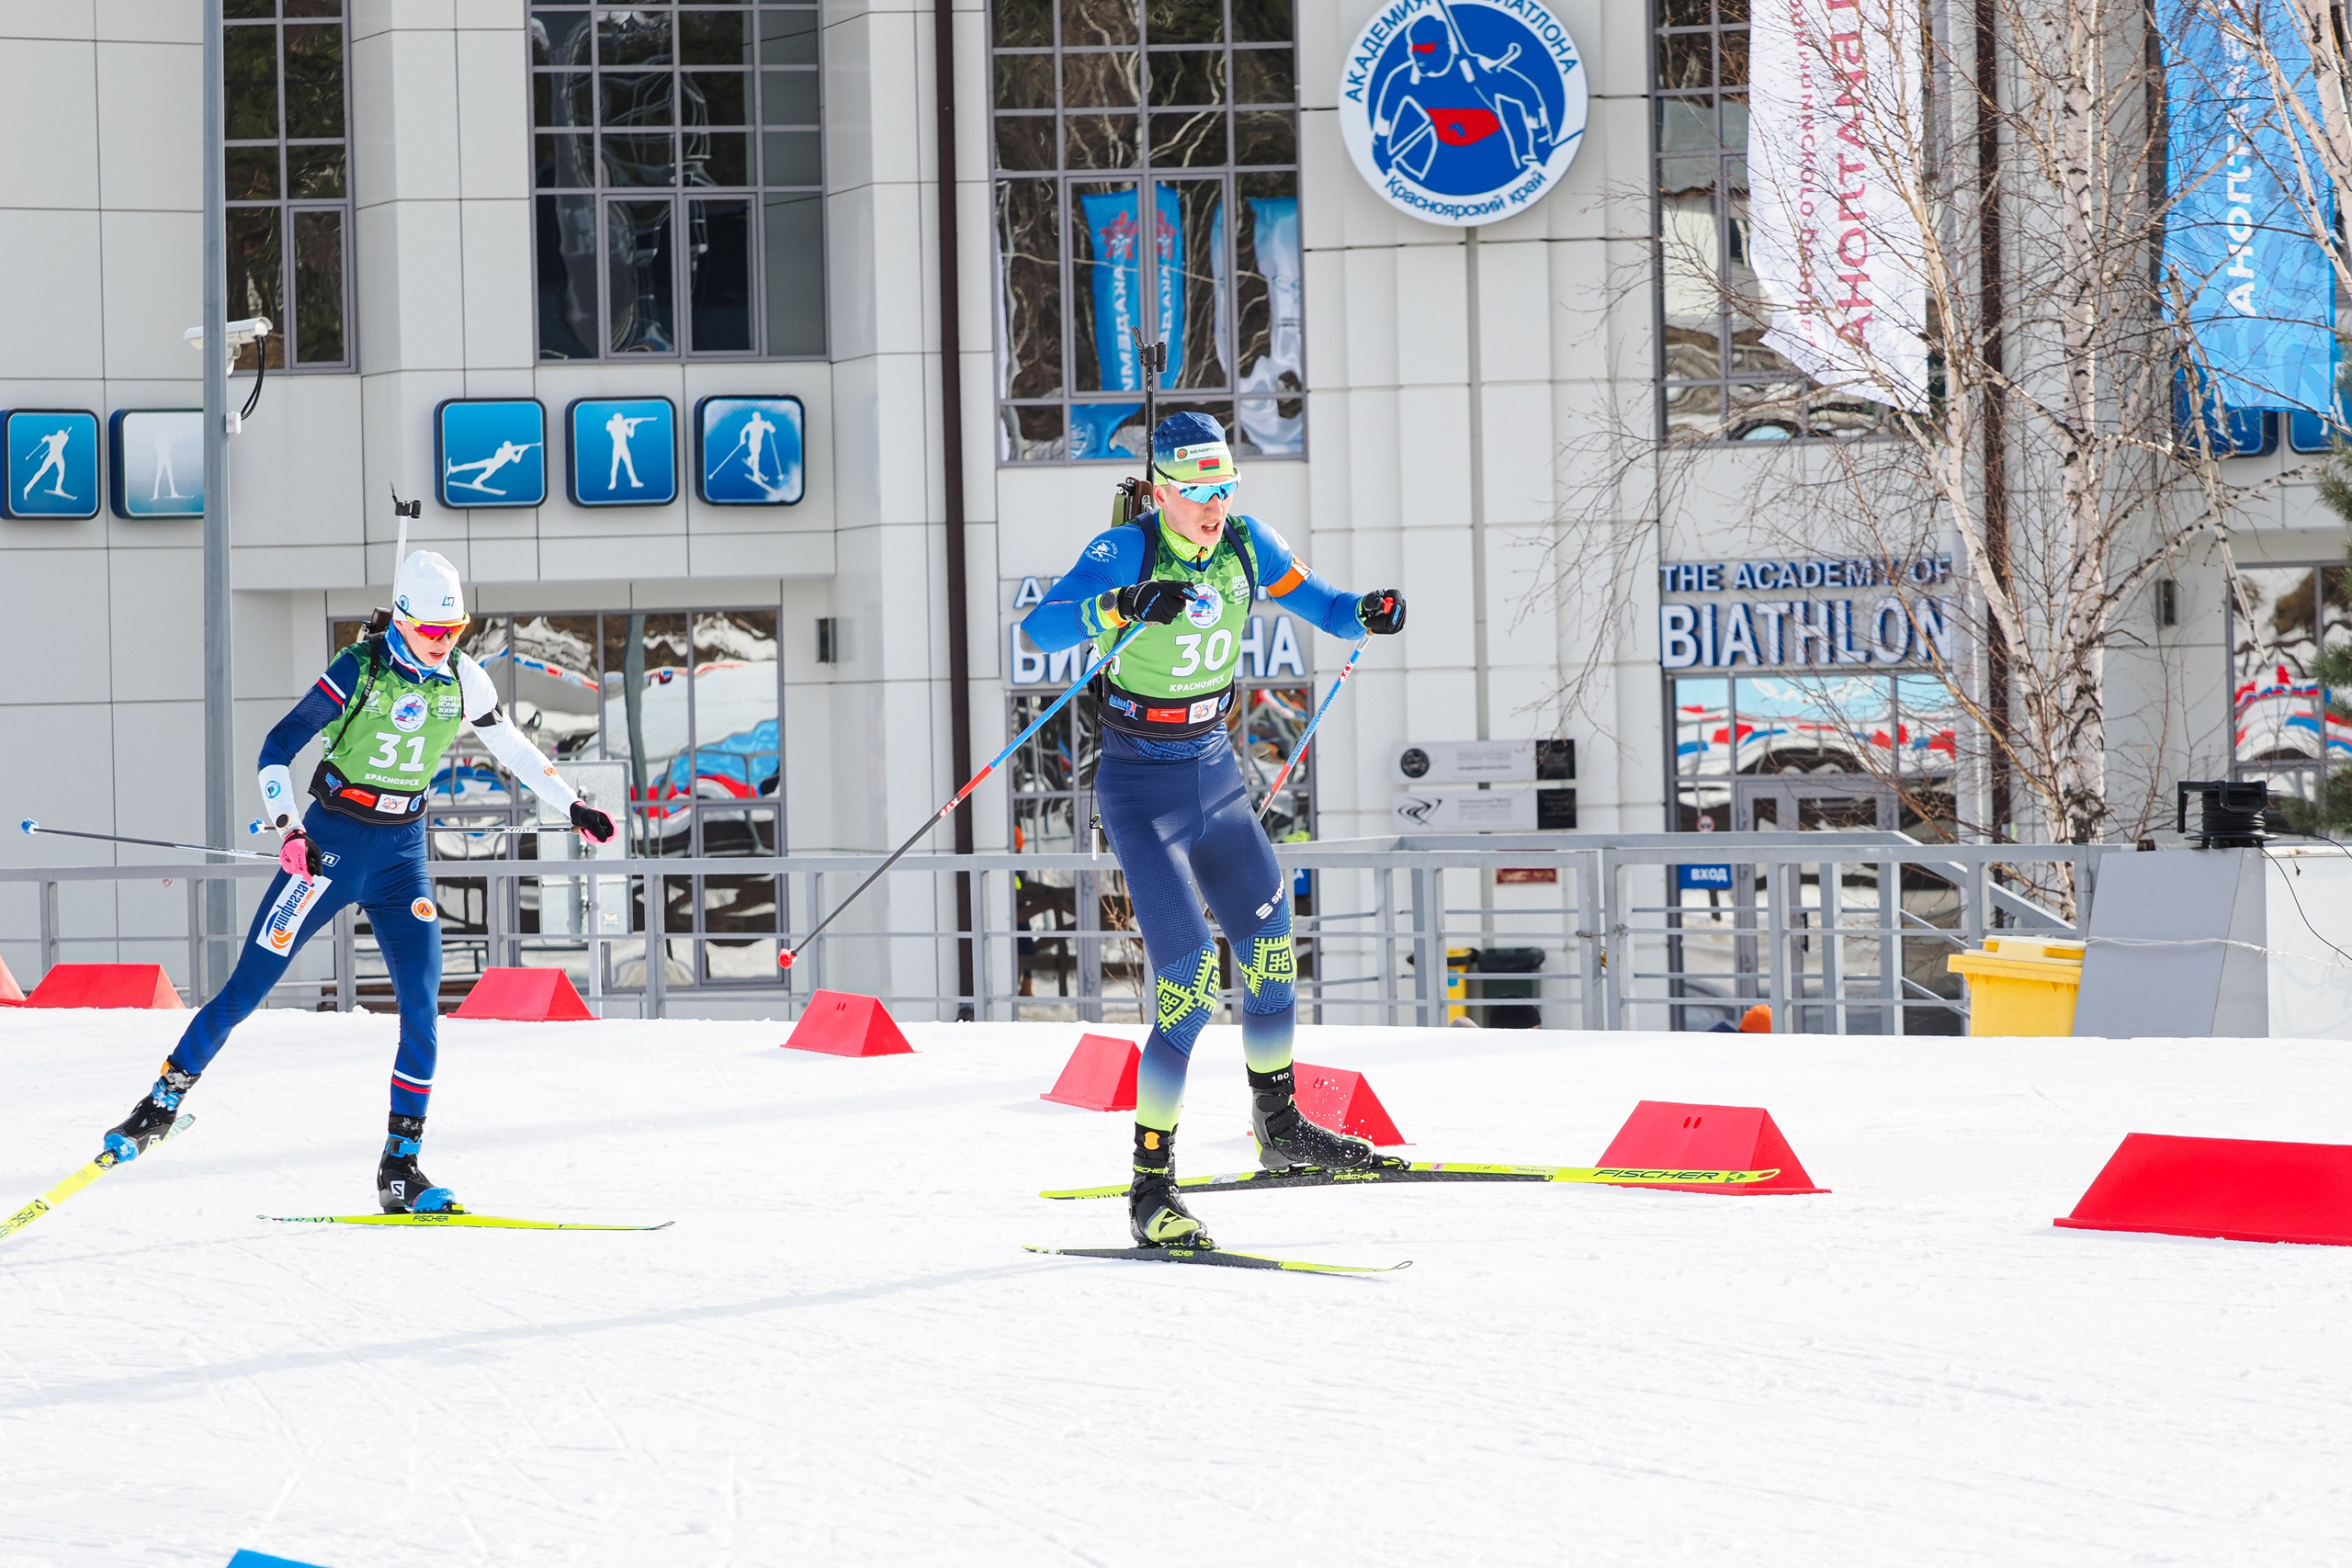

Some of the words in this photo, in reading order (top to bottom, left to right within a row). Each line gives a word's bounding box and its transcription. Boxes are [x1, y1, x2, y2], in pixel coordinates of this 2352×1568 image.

[1385, 175, 1507, 220] Красноярский
[1510, 170, 1547, 205] край
[1659, 563, 1724, 592] THE
[1733, 558, 1899, 591] ACADEMY
[1909, 556, 1952, 585] OF
[1659, 595, 1953, 670] BIATHLON
[1170, 627, 1233, 678] 30
[1170, 674, 1225, 693] КРАСНОЯРСК
[368, 731, 426, 773] 31
[364, 773, 420, 786] КРАСНОЯРСК
[1690, 867, 1727, 883] ВХОД
[1272, 1072, 1289, 1083] 180
[1334, 1173, 1380, 1181] FISCHER
[1593, 1169, 1720, 1179] FISCHER
[413, 1214, 449, 1223] FISCHER
